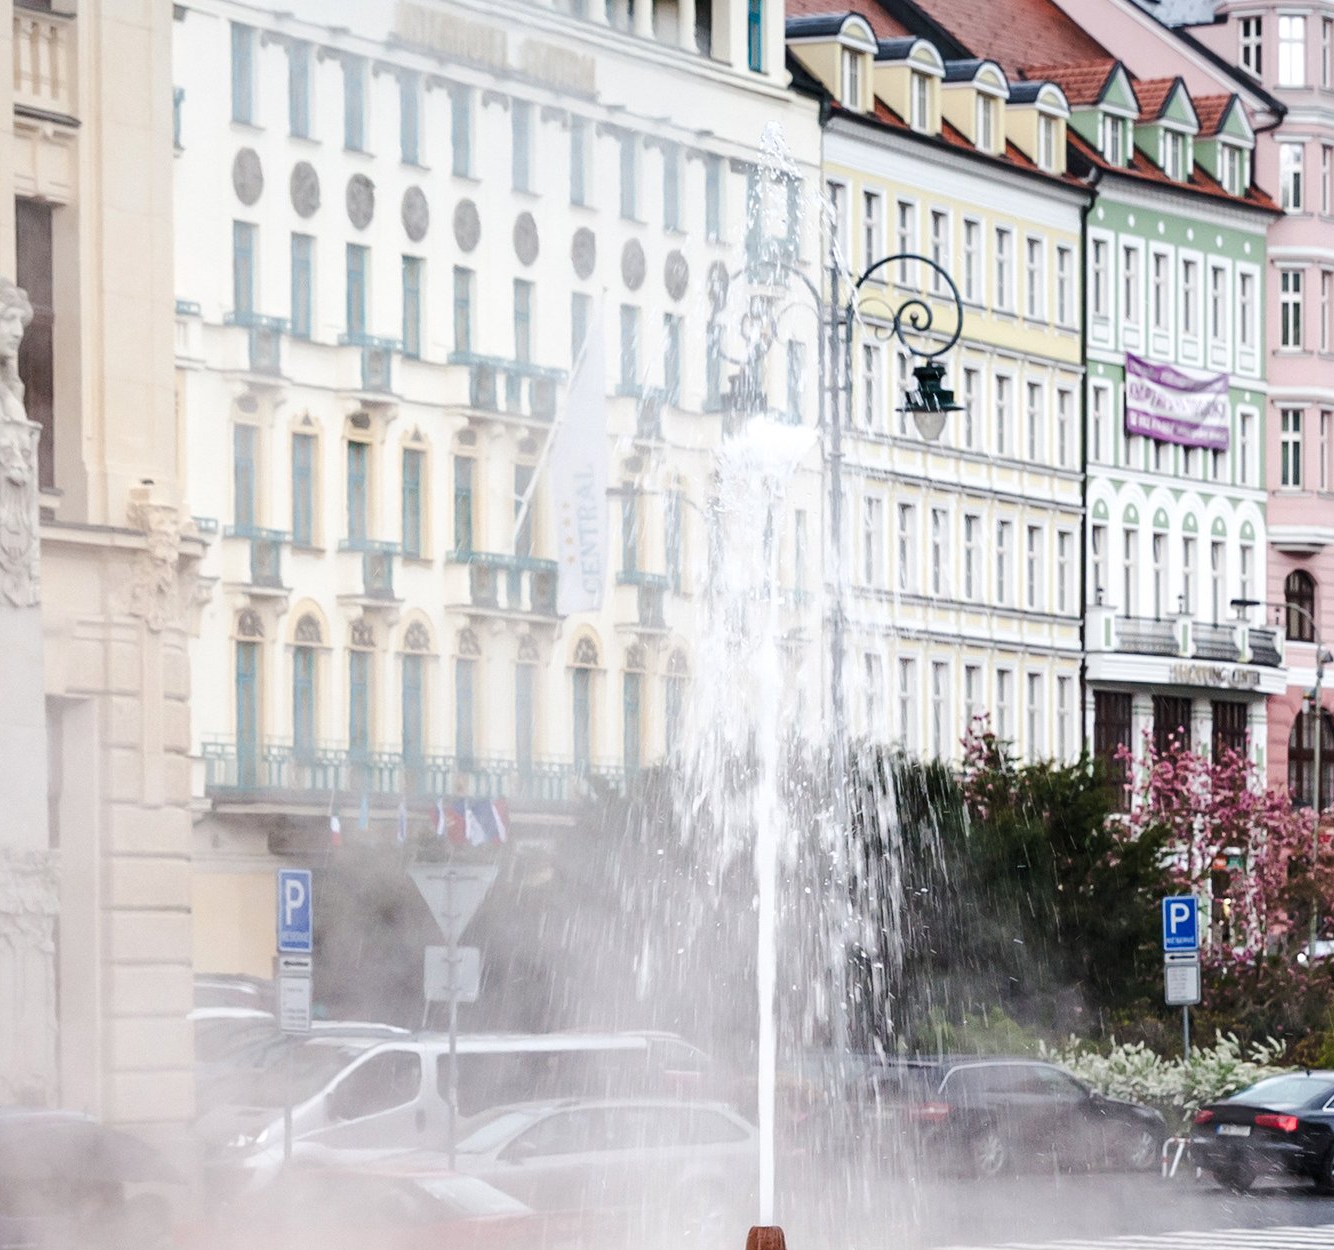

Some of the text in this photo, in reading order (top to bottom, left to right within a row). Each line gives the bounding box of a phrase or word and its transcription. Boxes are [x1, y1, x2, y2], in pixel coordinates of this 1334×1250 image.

[573, 463, 600, 592] CENTRAL
[285, 879, 305, 926] P
[1170, 903, 1190, 934] P
